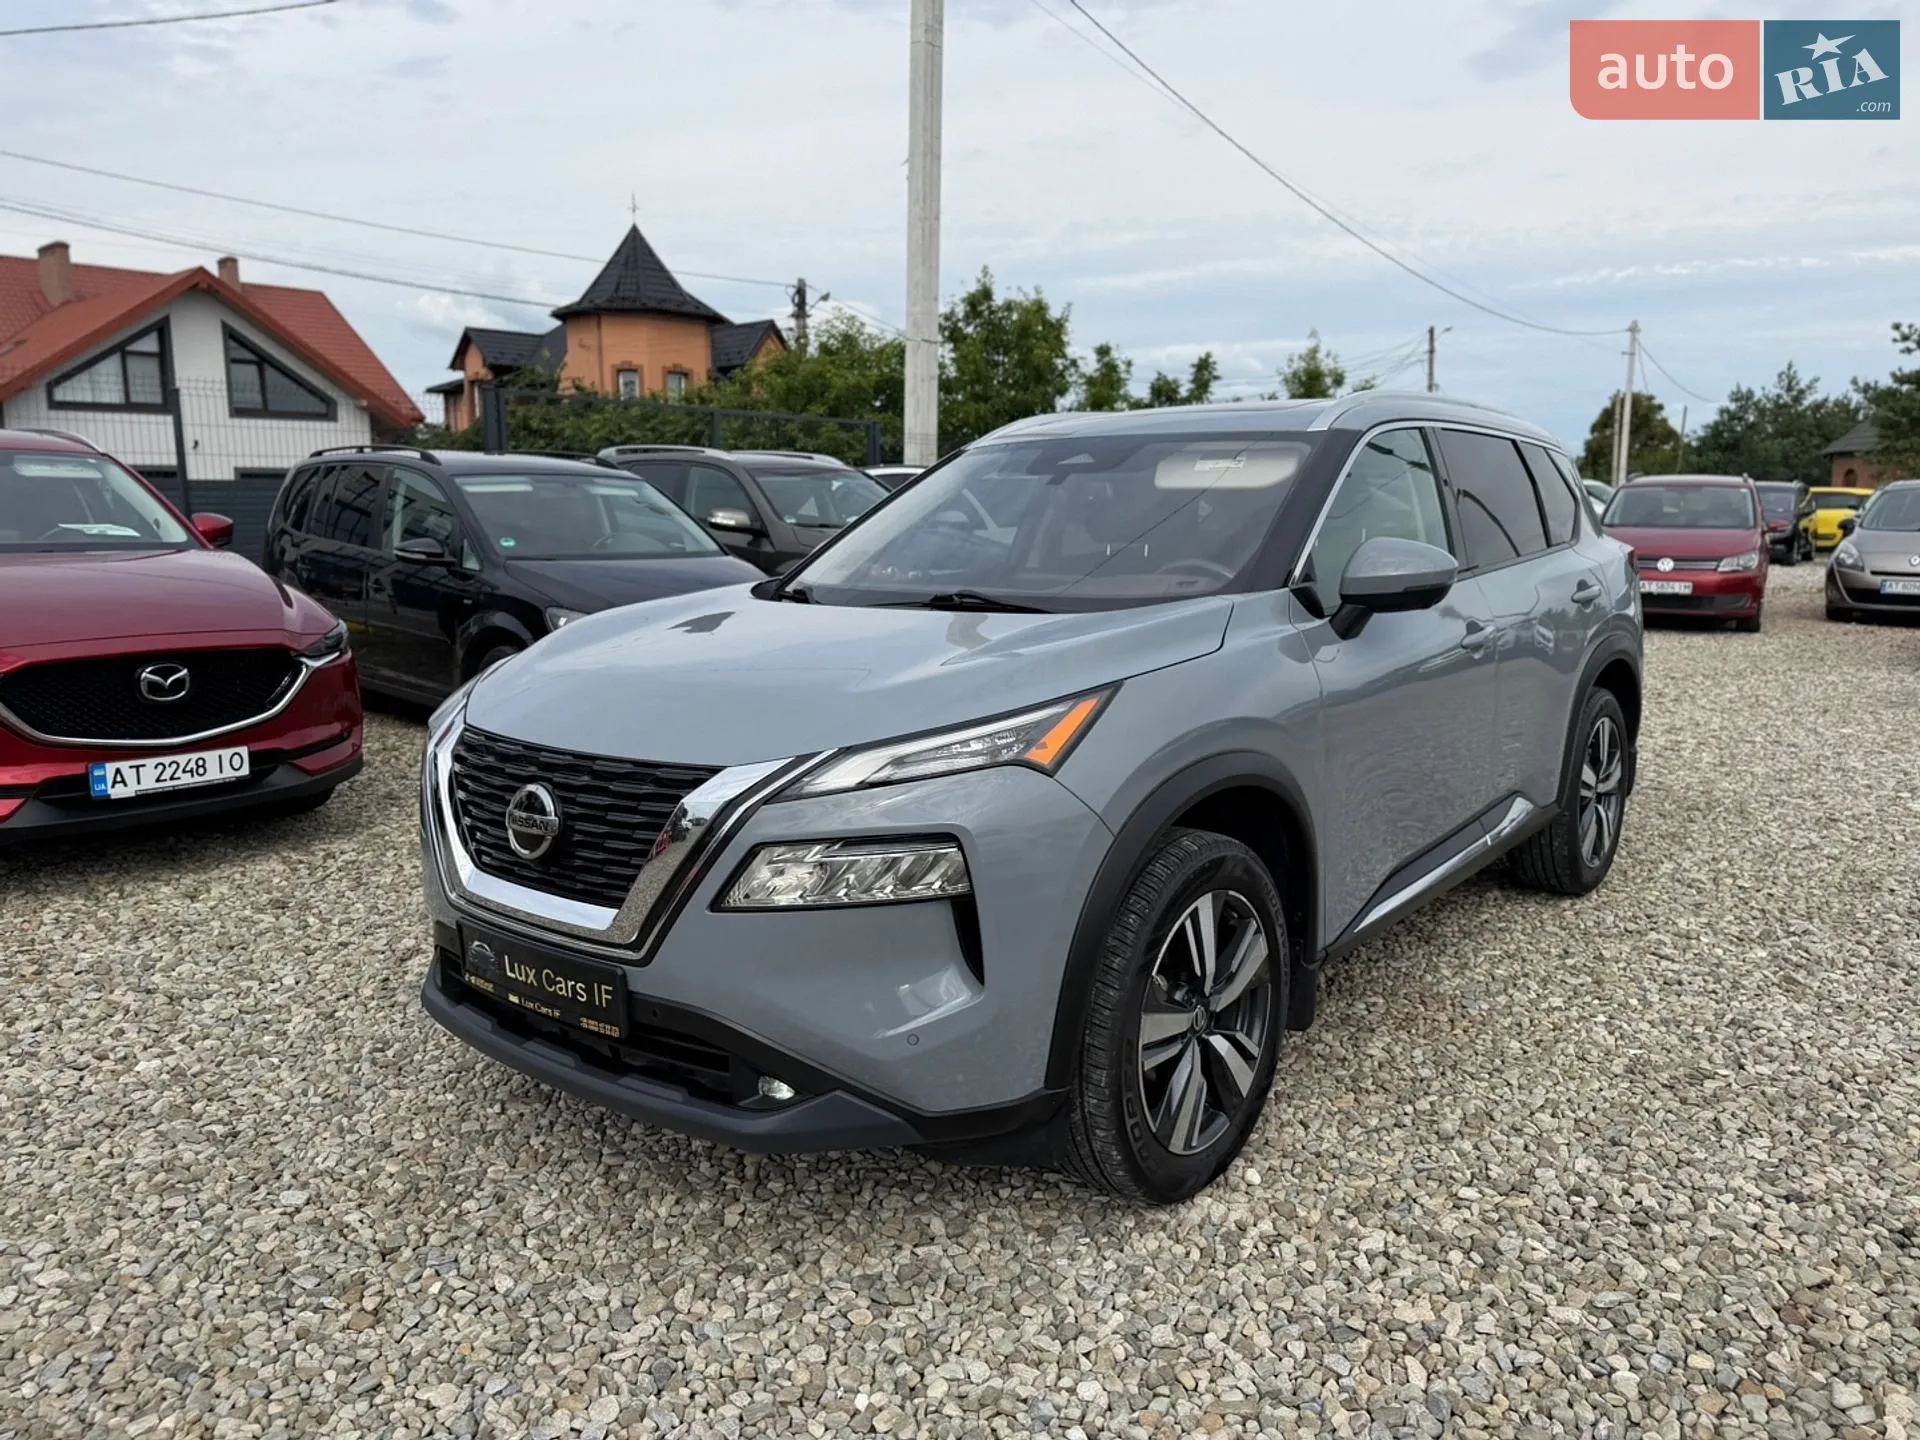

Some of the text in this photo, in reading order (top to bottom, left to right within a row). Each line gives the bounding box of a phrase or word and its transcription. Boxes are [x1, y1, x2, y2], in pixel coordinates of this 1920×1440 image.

[110, 763, 147, 790] AT
[154, 756, 208, 784] 2248
[218, 751, 245, 775] IO
[503, 954, 538, 987] Lux
[542, 968, 588, 1003] Cars
[594, 981, 614, 1009] IF
[535, 1002, 554, 1018] Cars
